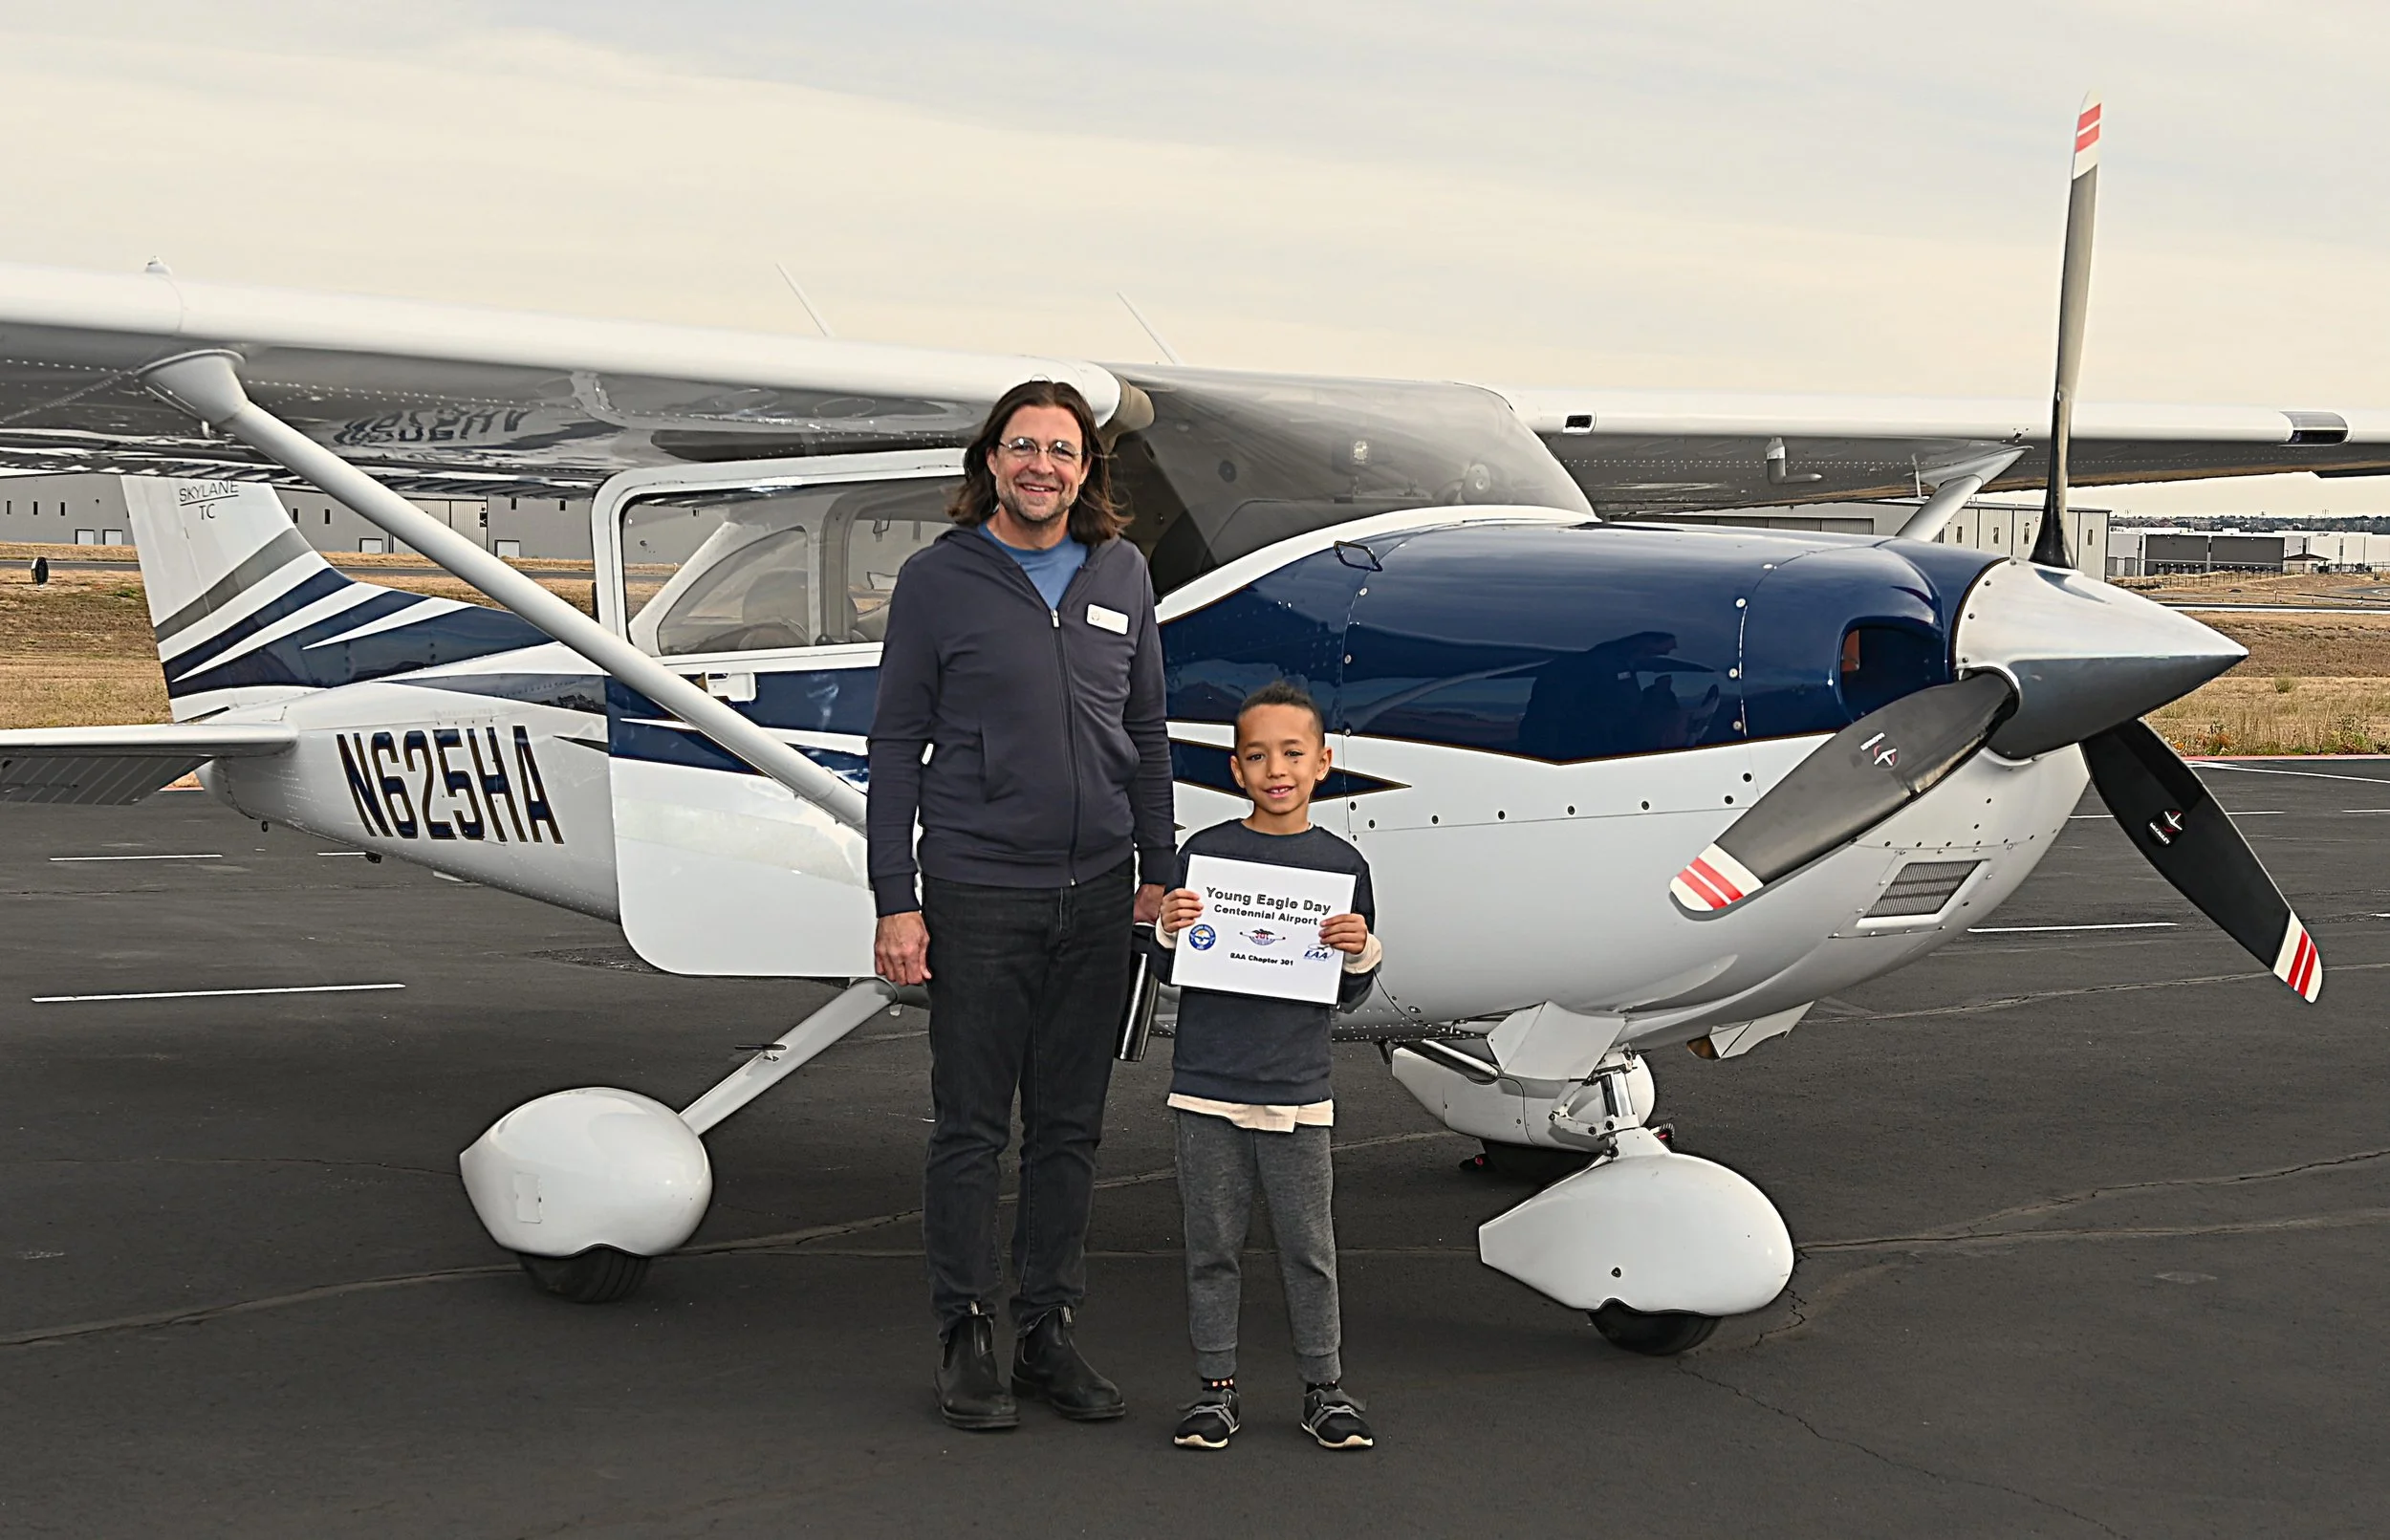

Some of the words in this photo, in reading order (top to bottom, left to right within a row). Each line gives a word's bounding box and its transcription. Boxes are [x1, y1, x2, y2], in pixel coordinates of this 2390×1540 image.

[179, 480, 239, 503] SKYLANE
[199, 503, 216, 520] TC
[336, 725, 565, 844] N625HA
[1206, 886, 1252, 906] Young
[1256, 893, 1299, 911] Eagle
[1303, 900, 1332, 916] Day
[1213, 904, 1275, 921] Centennial
[1277, 913, 1318, 925] Airport
[1248, 954, 1278, 965] Chapter
[1280, 958, 1293, 966] 301
